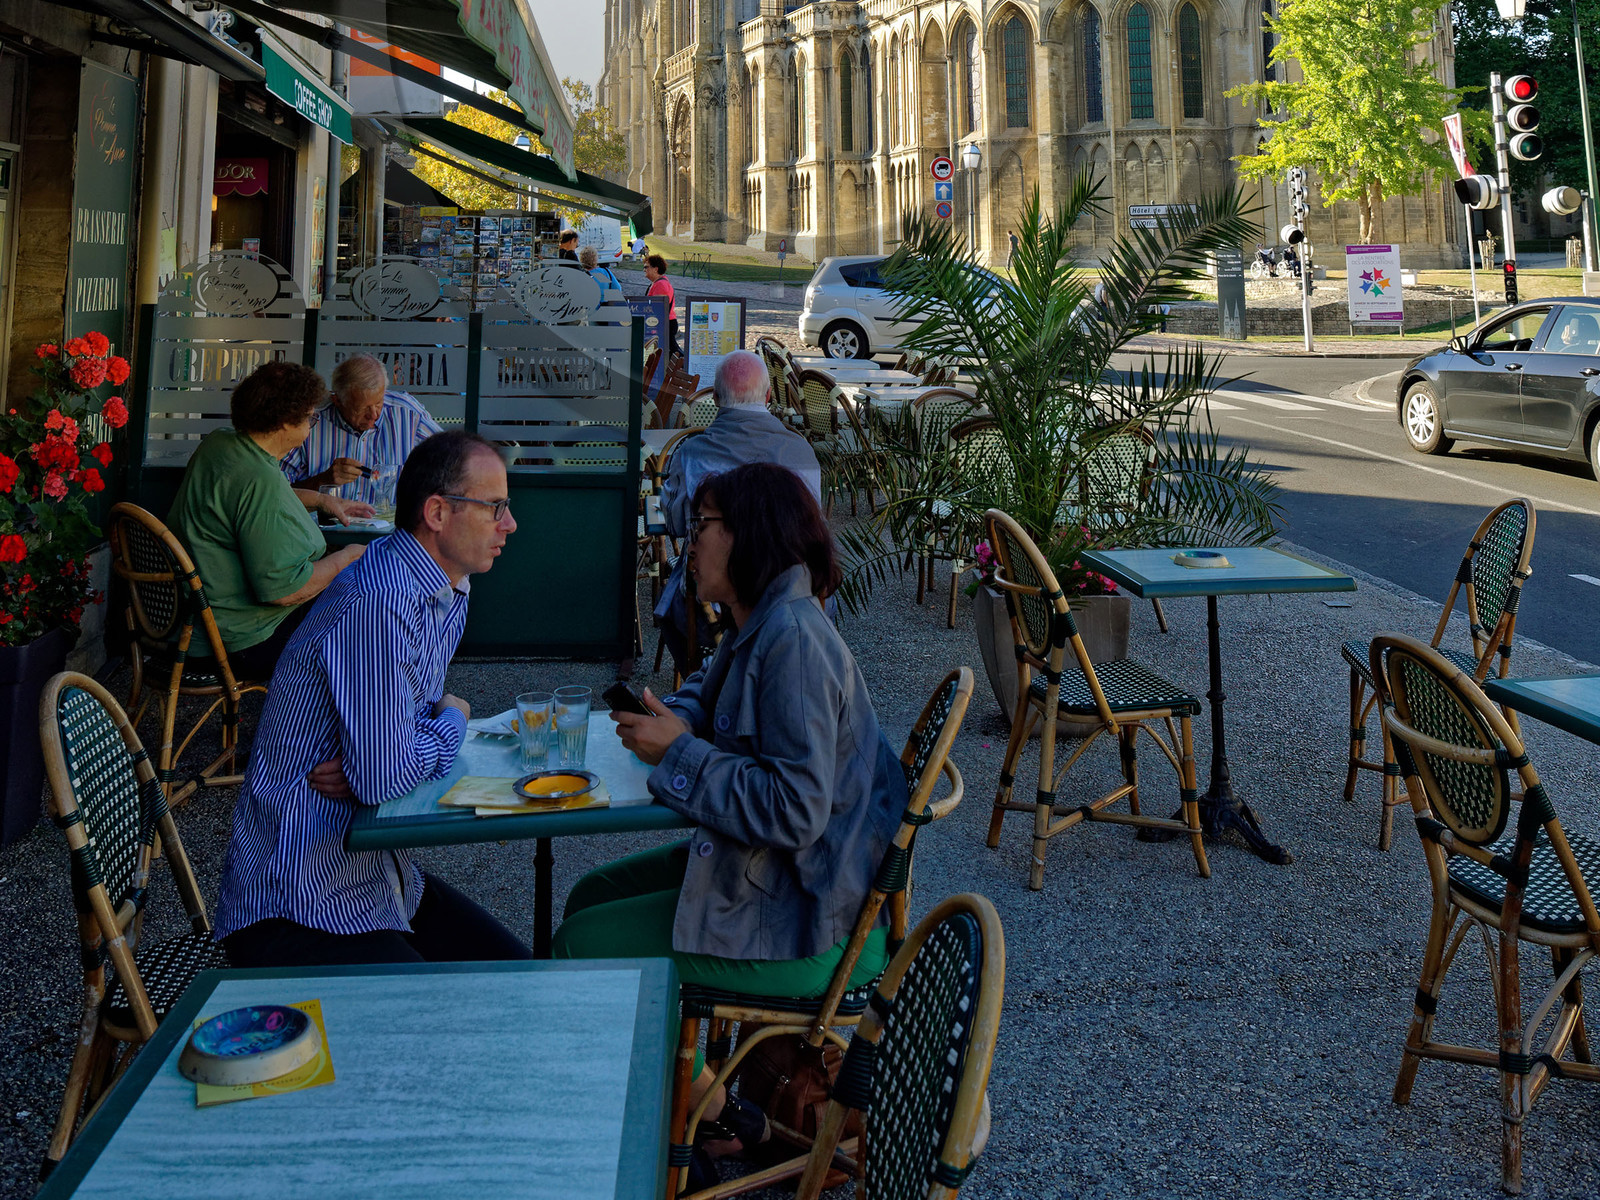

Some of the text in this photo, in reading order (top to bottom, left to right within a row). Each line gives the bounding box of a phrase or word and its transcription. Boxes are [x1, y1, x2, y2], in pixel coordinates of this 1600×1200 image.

[294, 78, 333, 128] COFFEE SHOP
[76, 207, 127, 246] BRASSERIE
[75, 277, 119, 313] PIZZERIA
[497, 355, 612, 391] BRASSERIE
